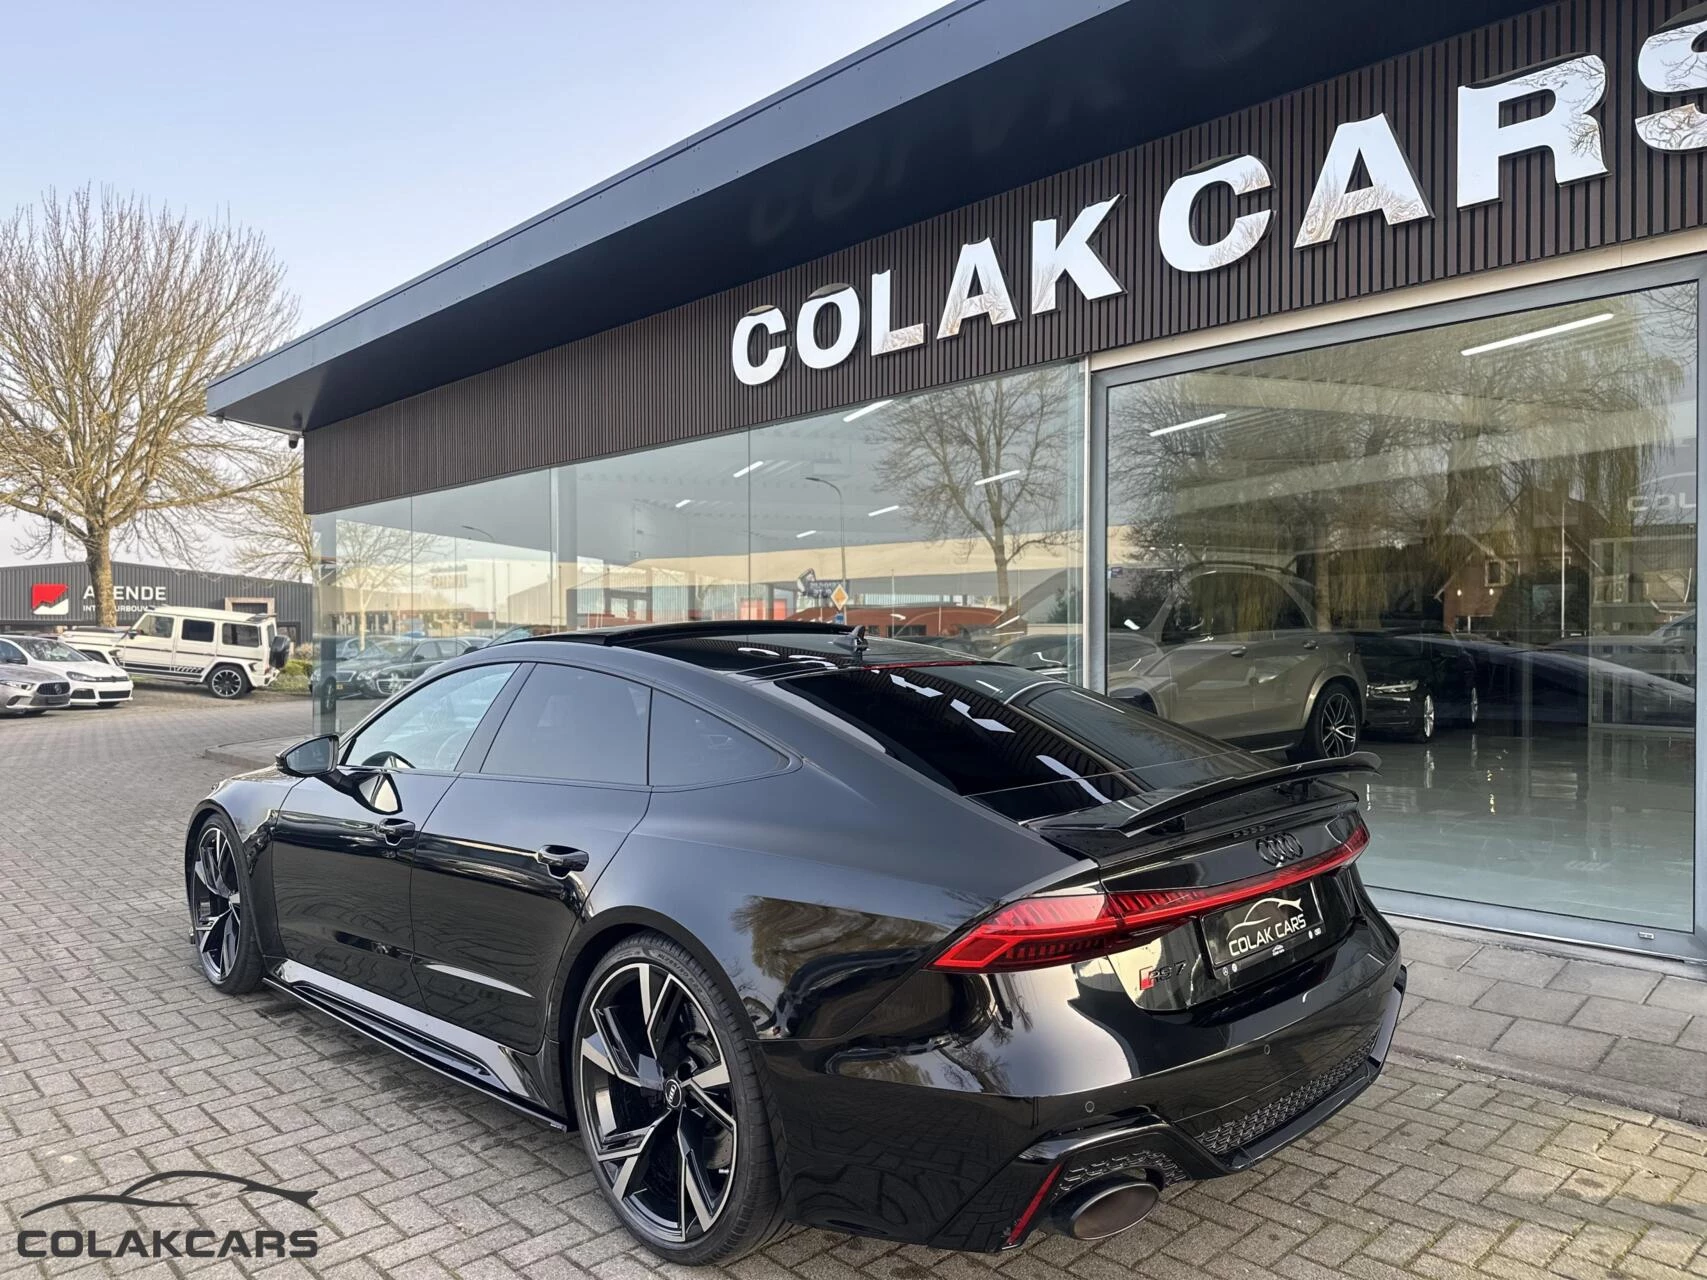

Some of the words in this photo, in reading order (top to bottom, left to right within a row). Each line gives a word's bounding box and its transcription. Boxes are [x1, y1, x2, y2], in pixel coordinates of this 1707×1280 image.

[731, 193, 1127, 386] COLAK
[83, 585, 167, 601] AENDE
[1228, 926, 1275, 956] COLAK
[1275, 913, 1307, 938] CARS
